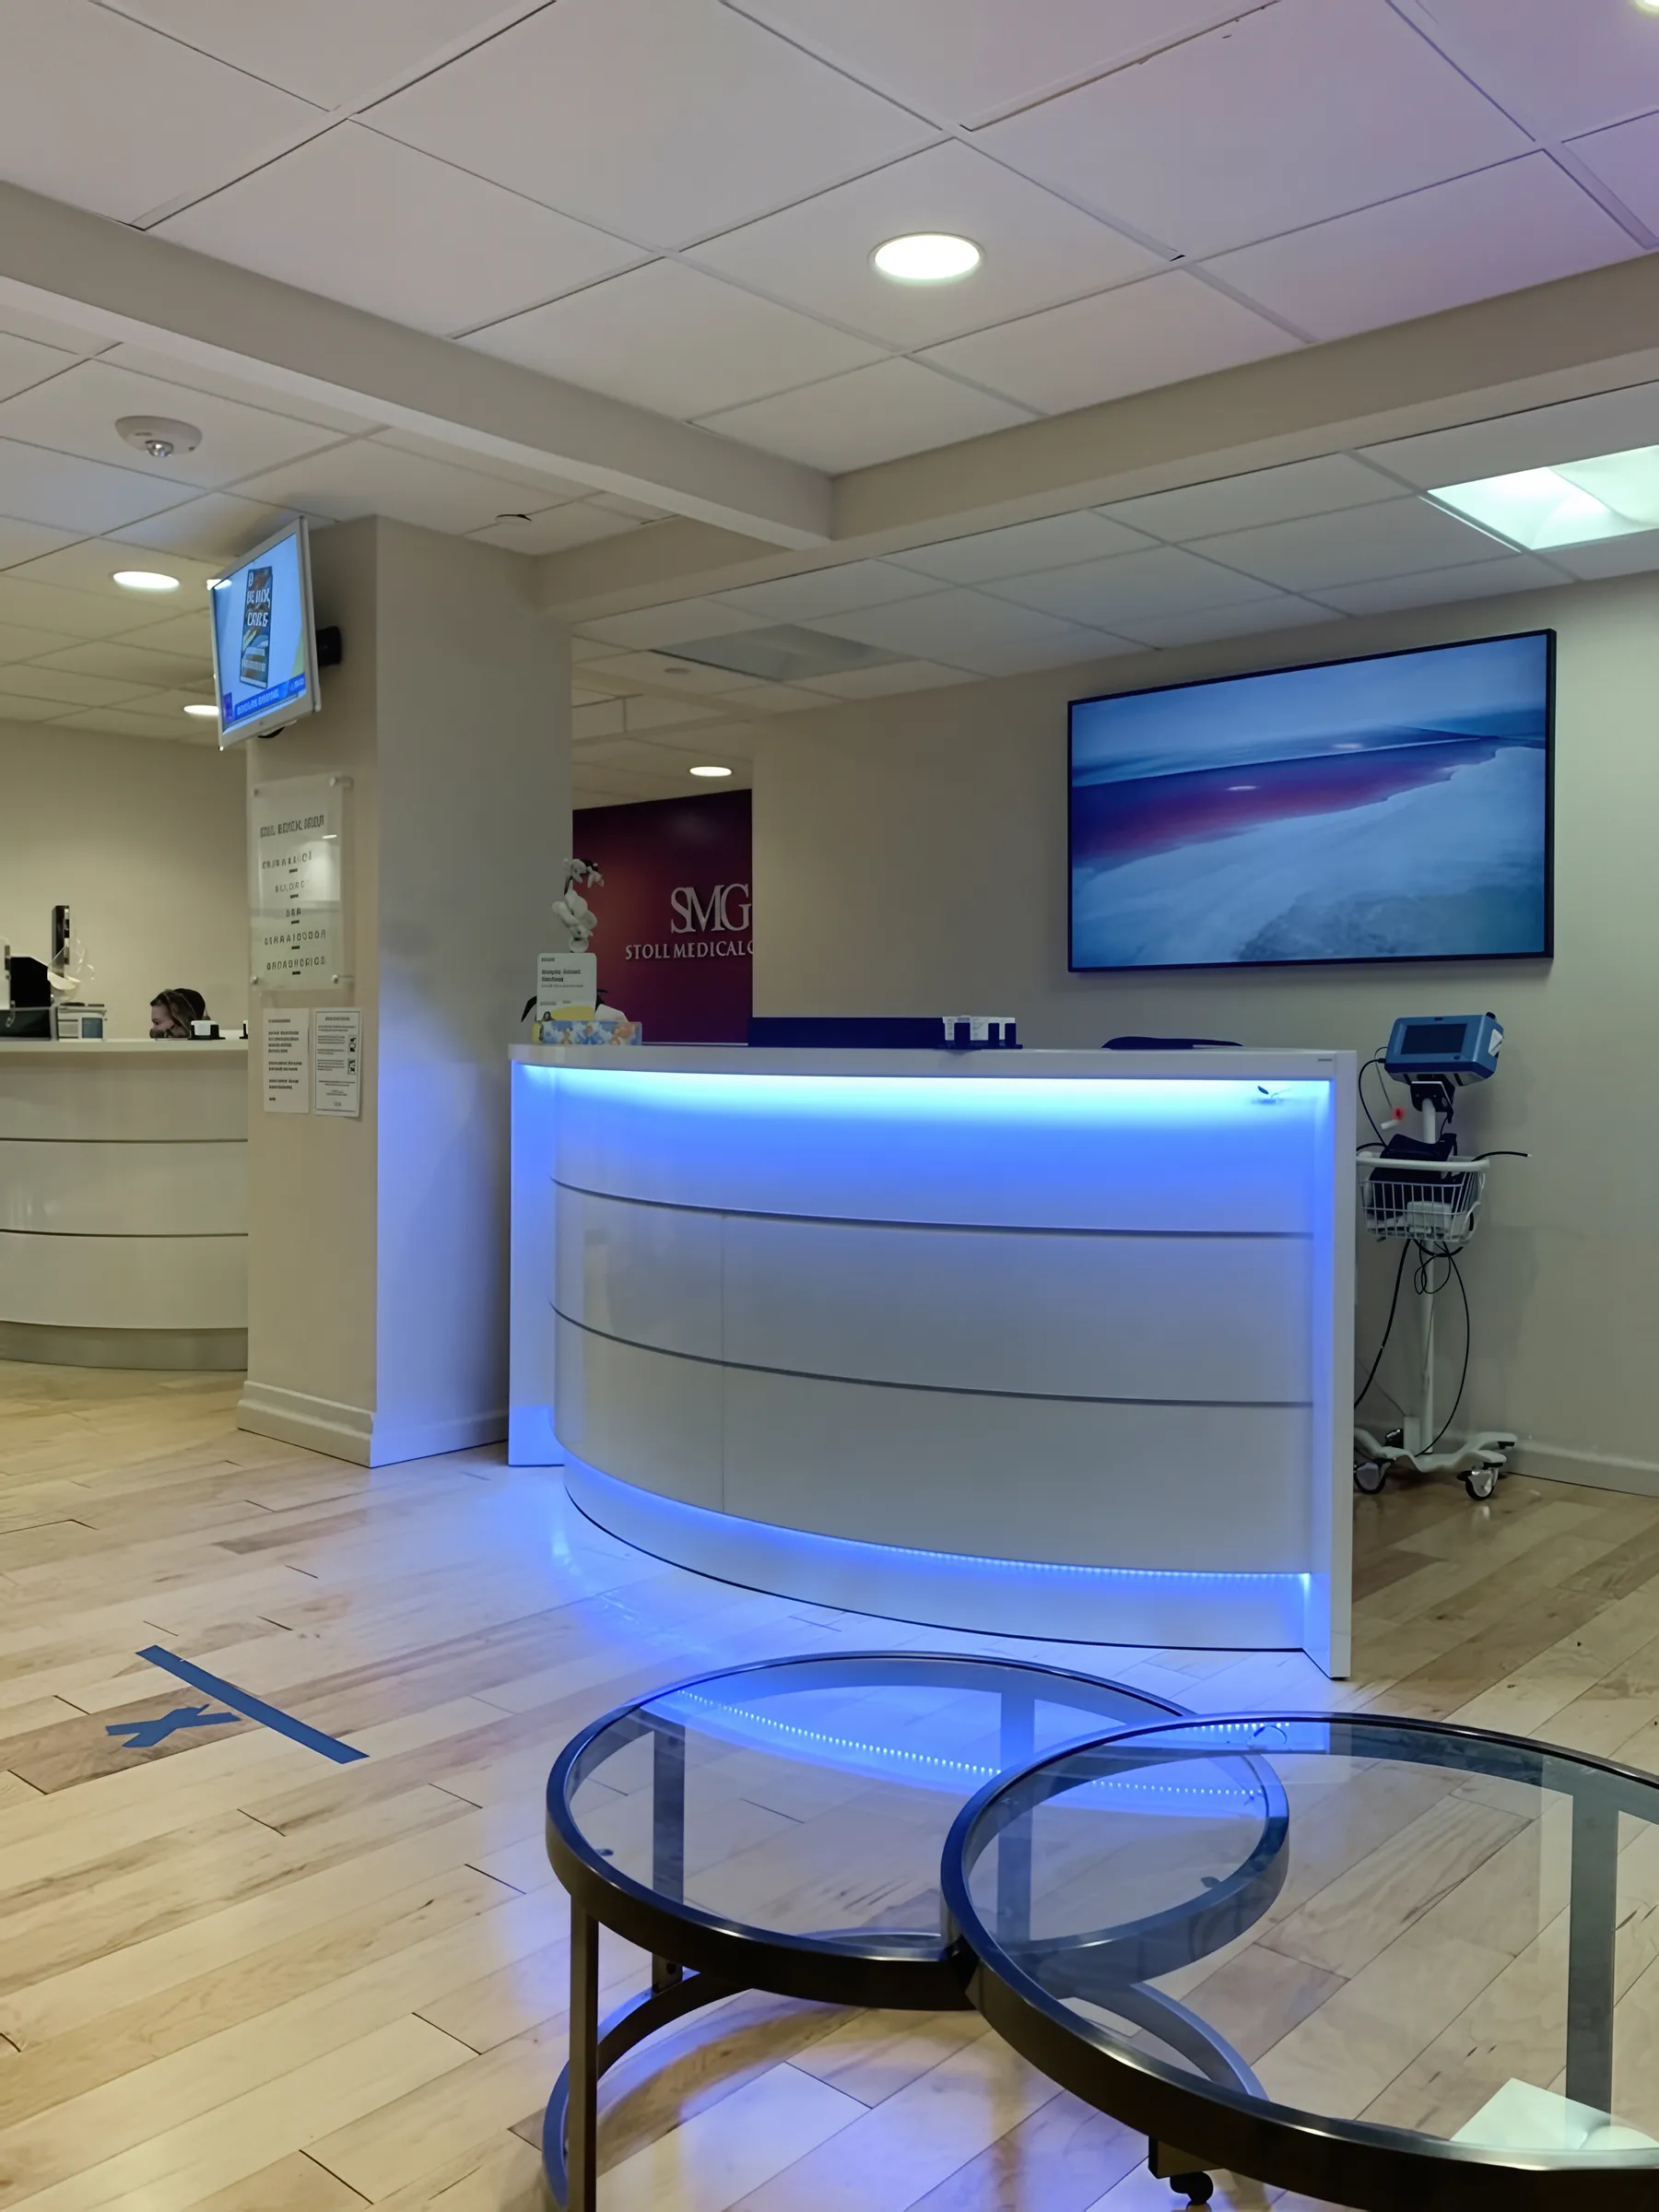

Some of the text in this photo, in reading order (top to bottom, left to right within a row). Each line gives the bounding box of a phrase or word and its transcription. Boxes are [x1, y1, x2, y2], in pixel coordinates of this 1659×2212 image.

[671, 883, 752, 934] SMG
[625, 944, 671, 959] STOLL
[674, 940, 746, 959] MEDICAL
